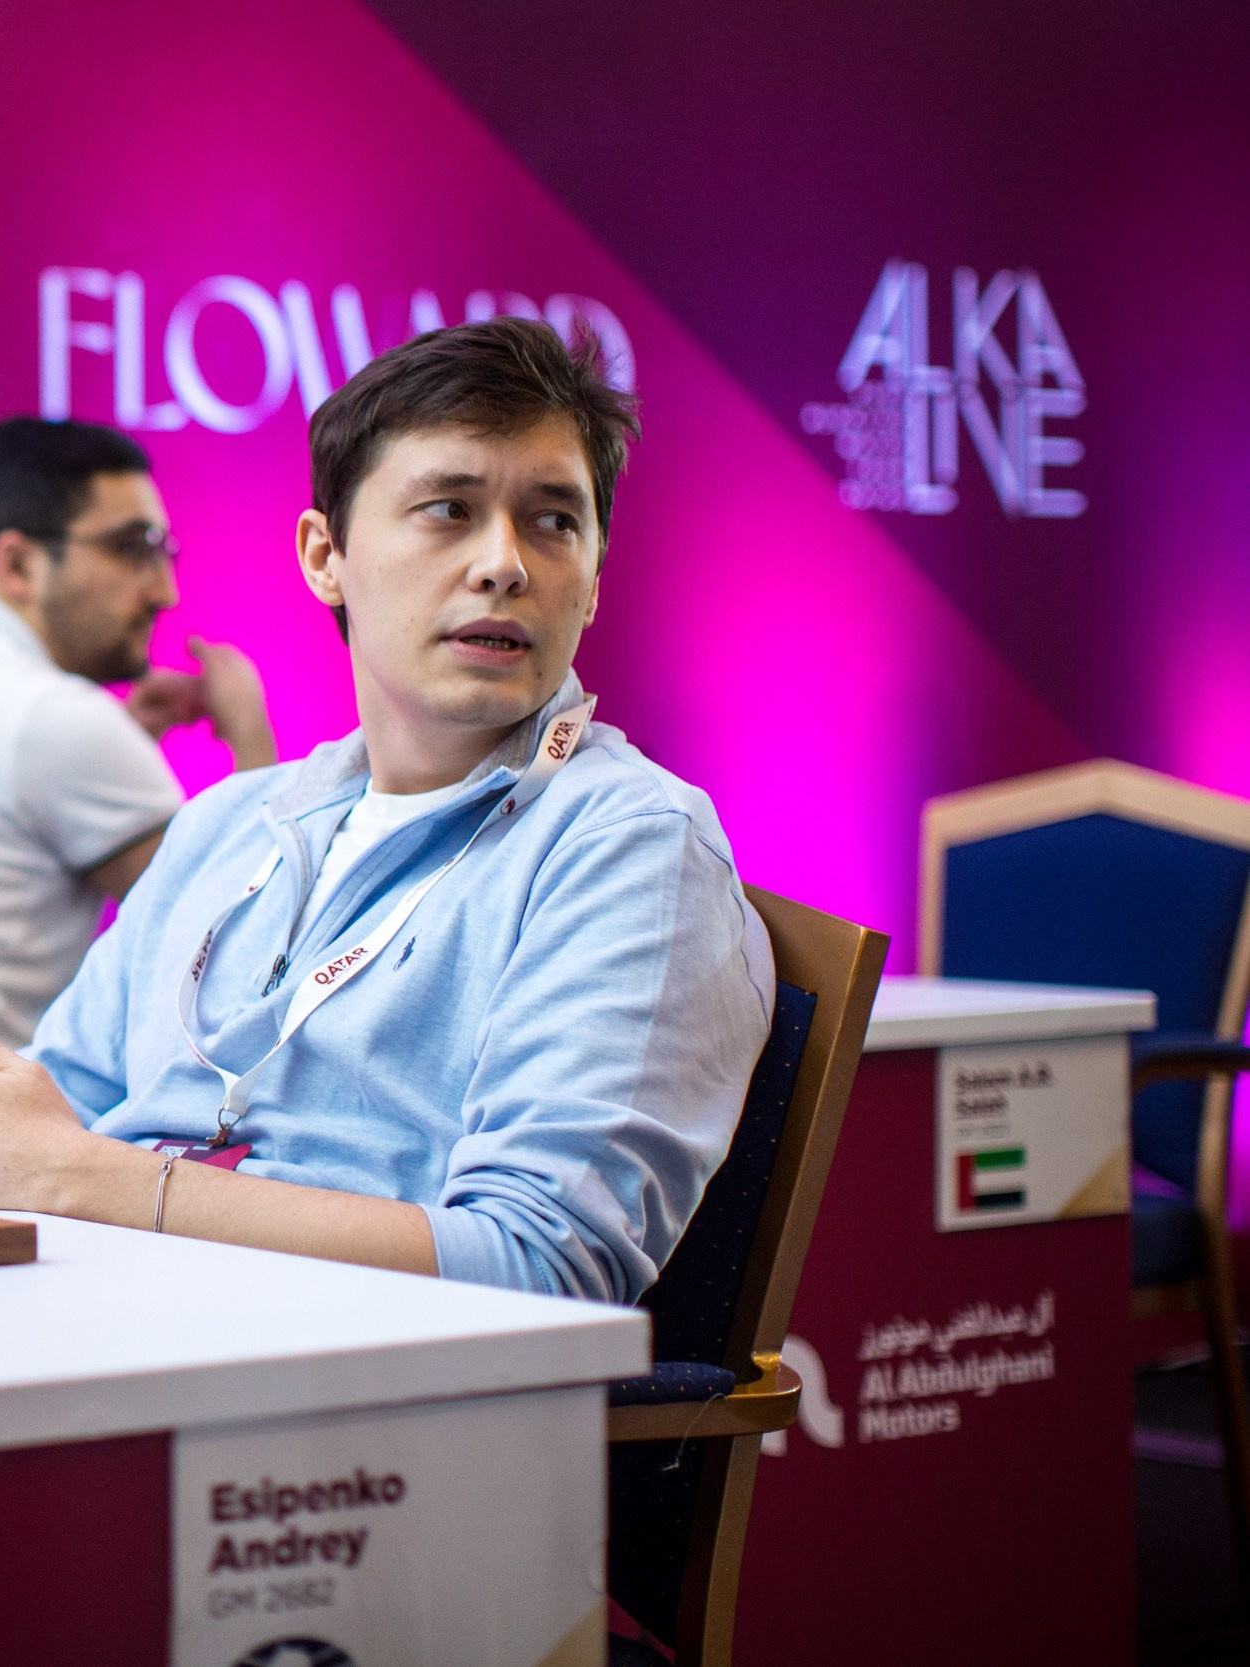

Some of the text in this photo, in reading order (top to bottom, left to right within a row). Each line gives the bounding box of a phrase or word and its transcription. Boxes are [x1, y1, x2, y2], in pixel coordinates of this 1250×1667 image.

[547, 721, 575, 760] QATAR
[314, 947, 368, 985] QATAR
[858, 1401, 961, 1444] Motors
[209, 1467, 407, 1523] Esipenko
[208, 1526, 368, 1574] Andrey
